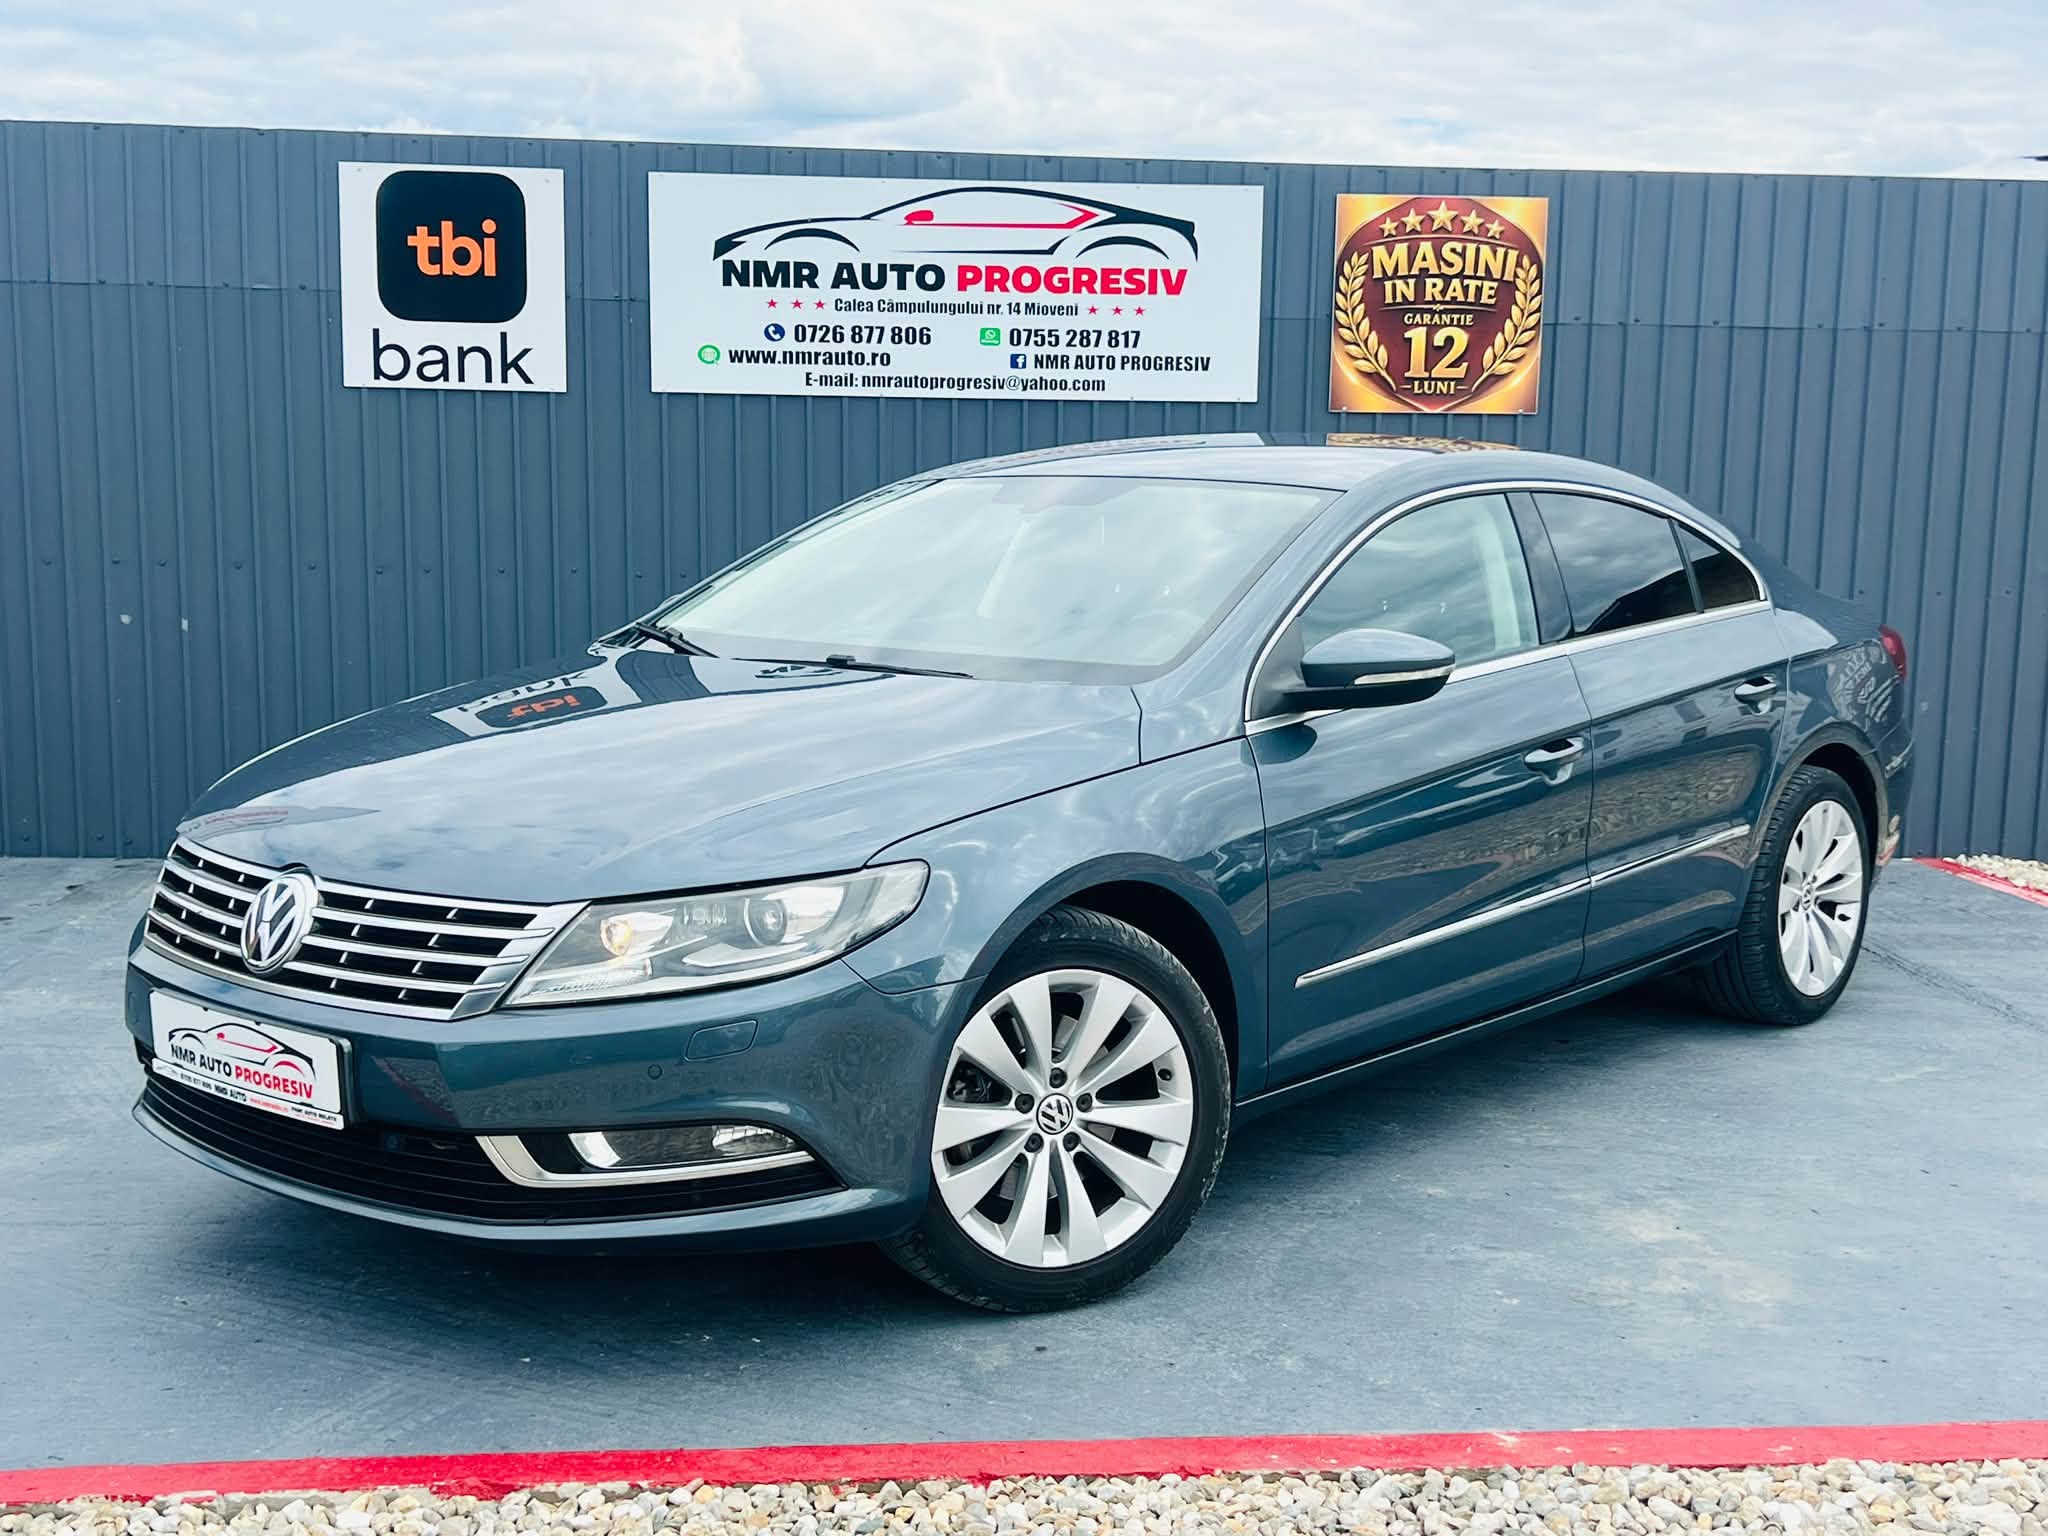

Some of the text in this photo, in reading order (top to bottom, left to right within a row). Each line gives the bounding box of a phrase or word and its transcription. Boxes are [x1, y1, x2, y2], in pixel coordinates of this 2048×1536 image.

[407, 218, 497, 277] tbi
[1370, 241, 1520, 283] MASINI
[722, 259, 1188, 296] NMR AUTO PROGRESIV
[1384, 278, 1499, 305] IN RATE
[834, 298, 874, 313] Calea
[987, 303, 1004, 316] nr.
[1007, 302, 1021, 315] 14
[1024, 302, 1079, 317] Mioveni
[1403, 313, 1474, 326] GARANTIE
[794, 324, 932, 346] 0726 877 806
[1009, 328, 1141, 349] 0755 287 817
[372, 328, 535, 385] bank
[728, 349, 892, 367] www.nmrauto.ro
[1034, 354, 1211, 372] NMR AUTO PROGRESIV
[1403, 326, 1470, 379] 12
[805, 372, 1106, 392] E-mail: nmrautoprogresiv@yahoo.com
[1413, 381, 1456, 395] LUNI
[170, 1043, 198, 1066] NMR
[199, 1054, 232, 1078] AUTO
[234, 1065, 314, 1100] PROGRESIV
